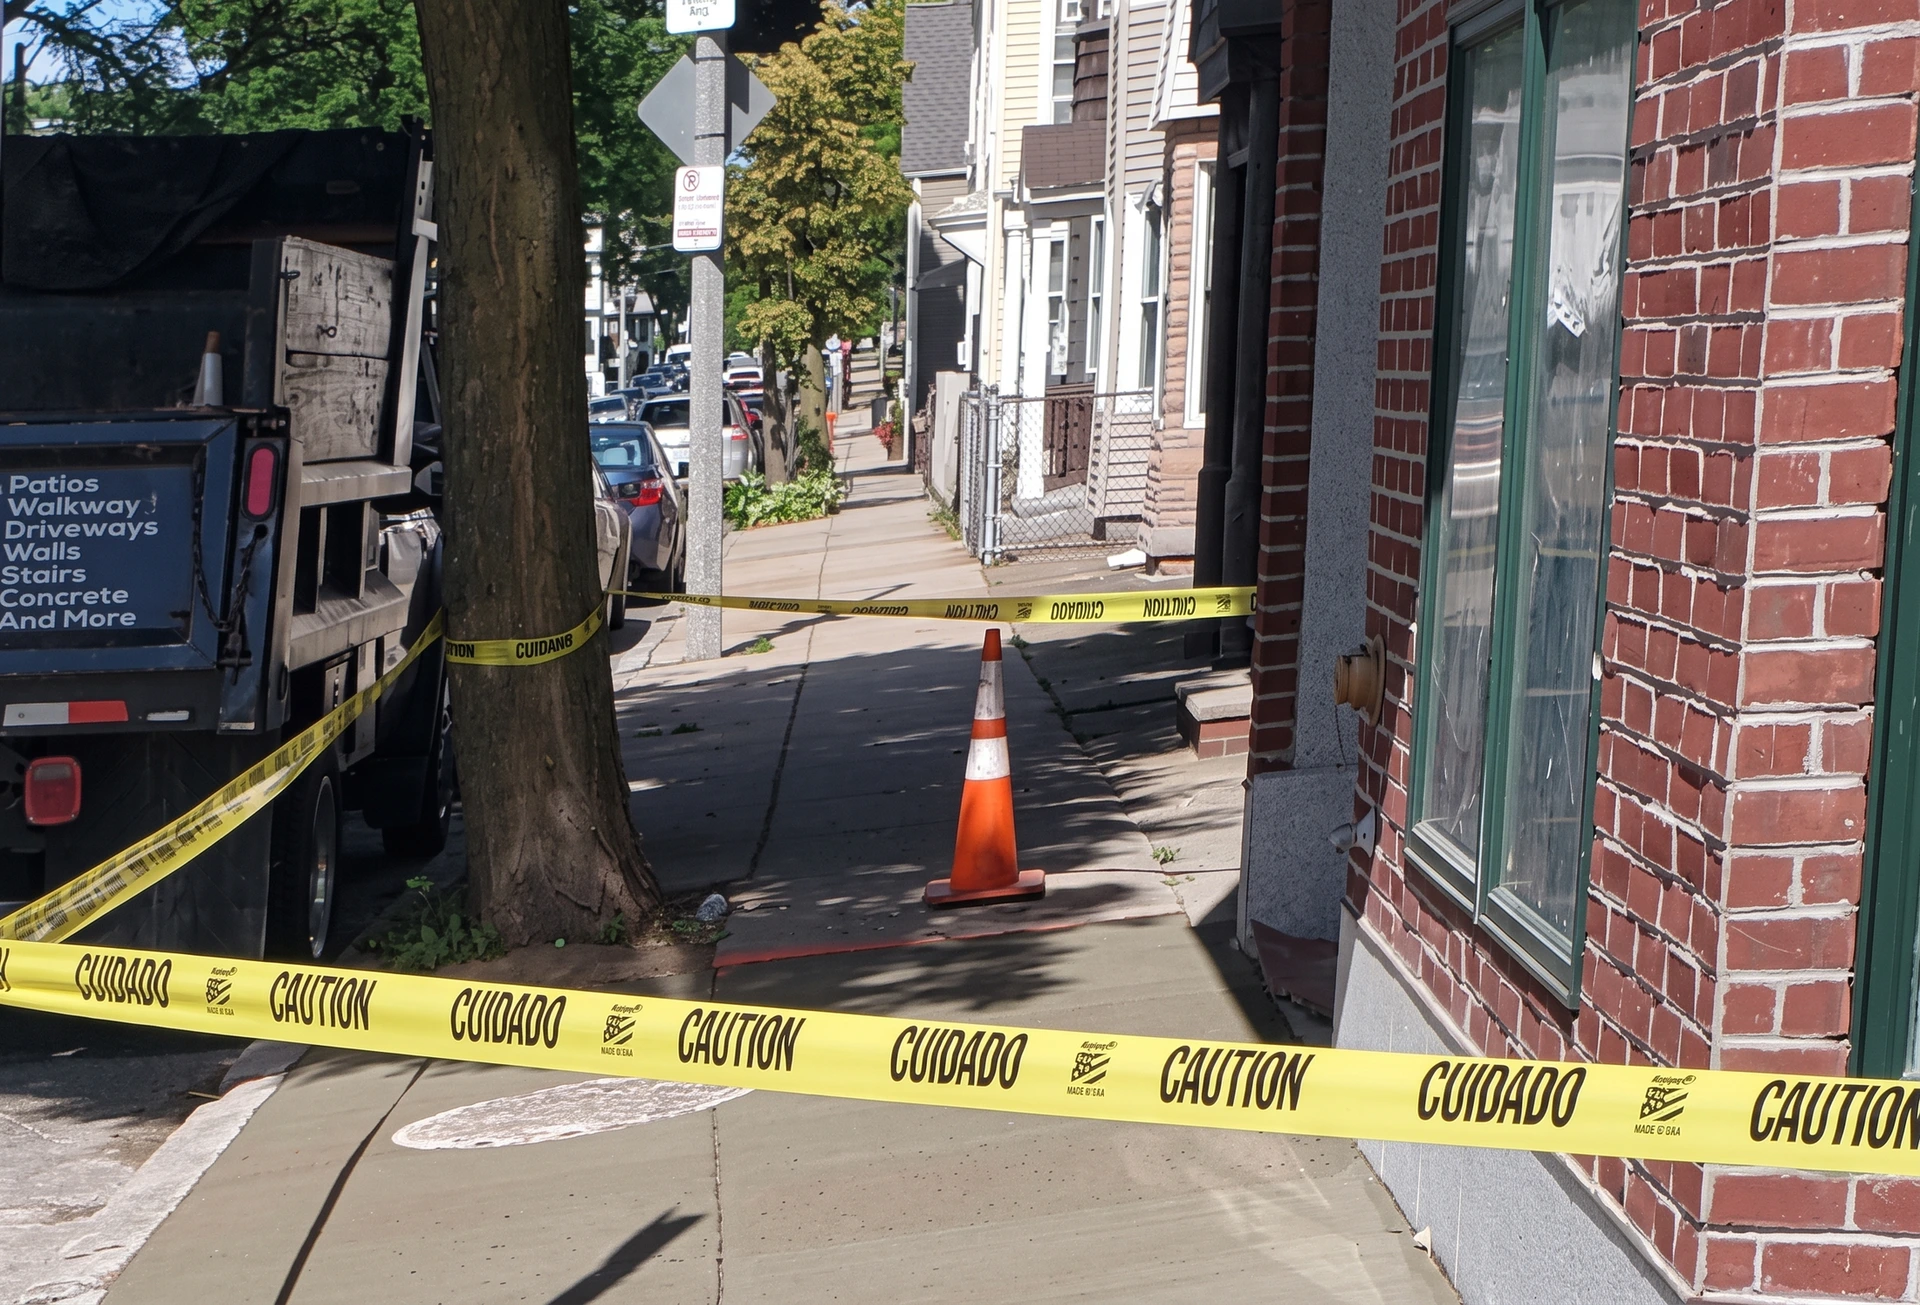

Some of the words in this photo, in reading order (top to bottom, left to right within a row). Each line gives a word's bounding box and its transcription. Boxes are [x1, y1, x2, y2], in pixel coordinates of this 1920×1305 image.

[9, 475, 99, 494] Patios
[5, 520, 158, 541] Driveways
[3, 541, 81, 562] Walls
[1, 564, 87, 585] Stairs
[0, 588, 128, 607] Concrete
[0, 610, 56, 630] And
[63, 609, 136, 628] More
[75, 953, 172, 1008] CUIDADO
[270, 971, 377, 1031] CAUTION
[450, 987, 566, 1049] CUIDADO
[678, 1008, 806, 1071] CAUTION
[890, 1025, 1028, 1090] CUIDADO
[1160, 1045, 1315, 1111] CAUTION
[1417, 1060, 1587, 1128] CUIDADO
[1750, 1079, 1920, 1150] CAUTION
[1633, 1124, 1656, 1135] MADE
